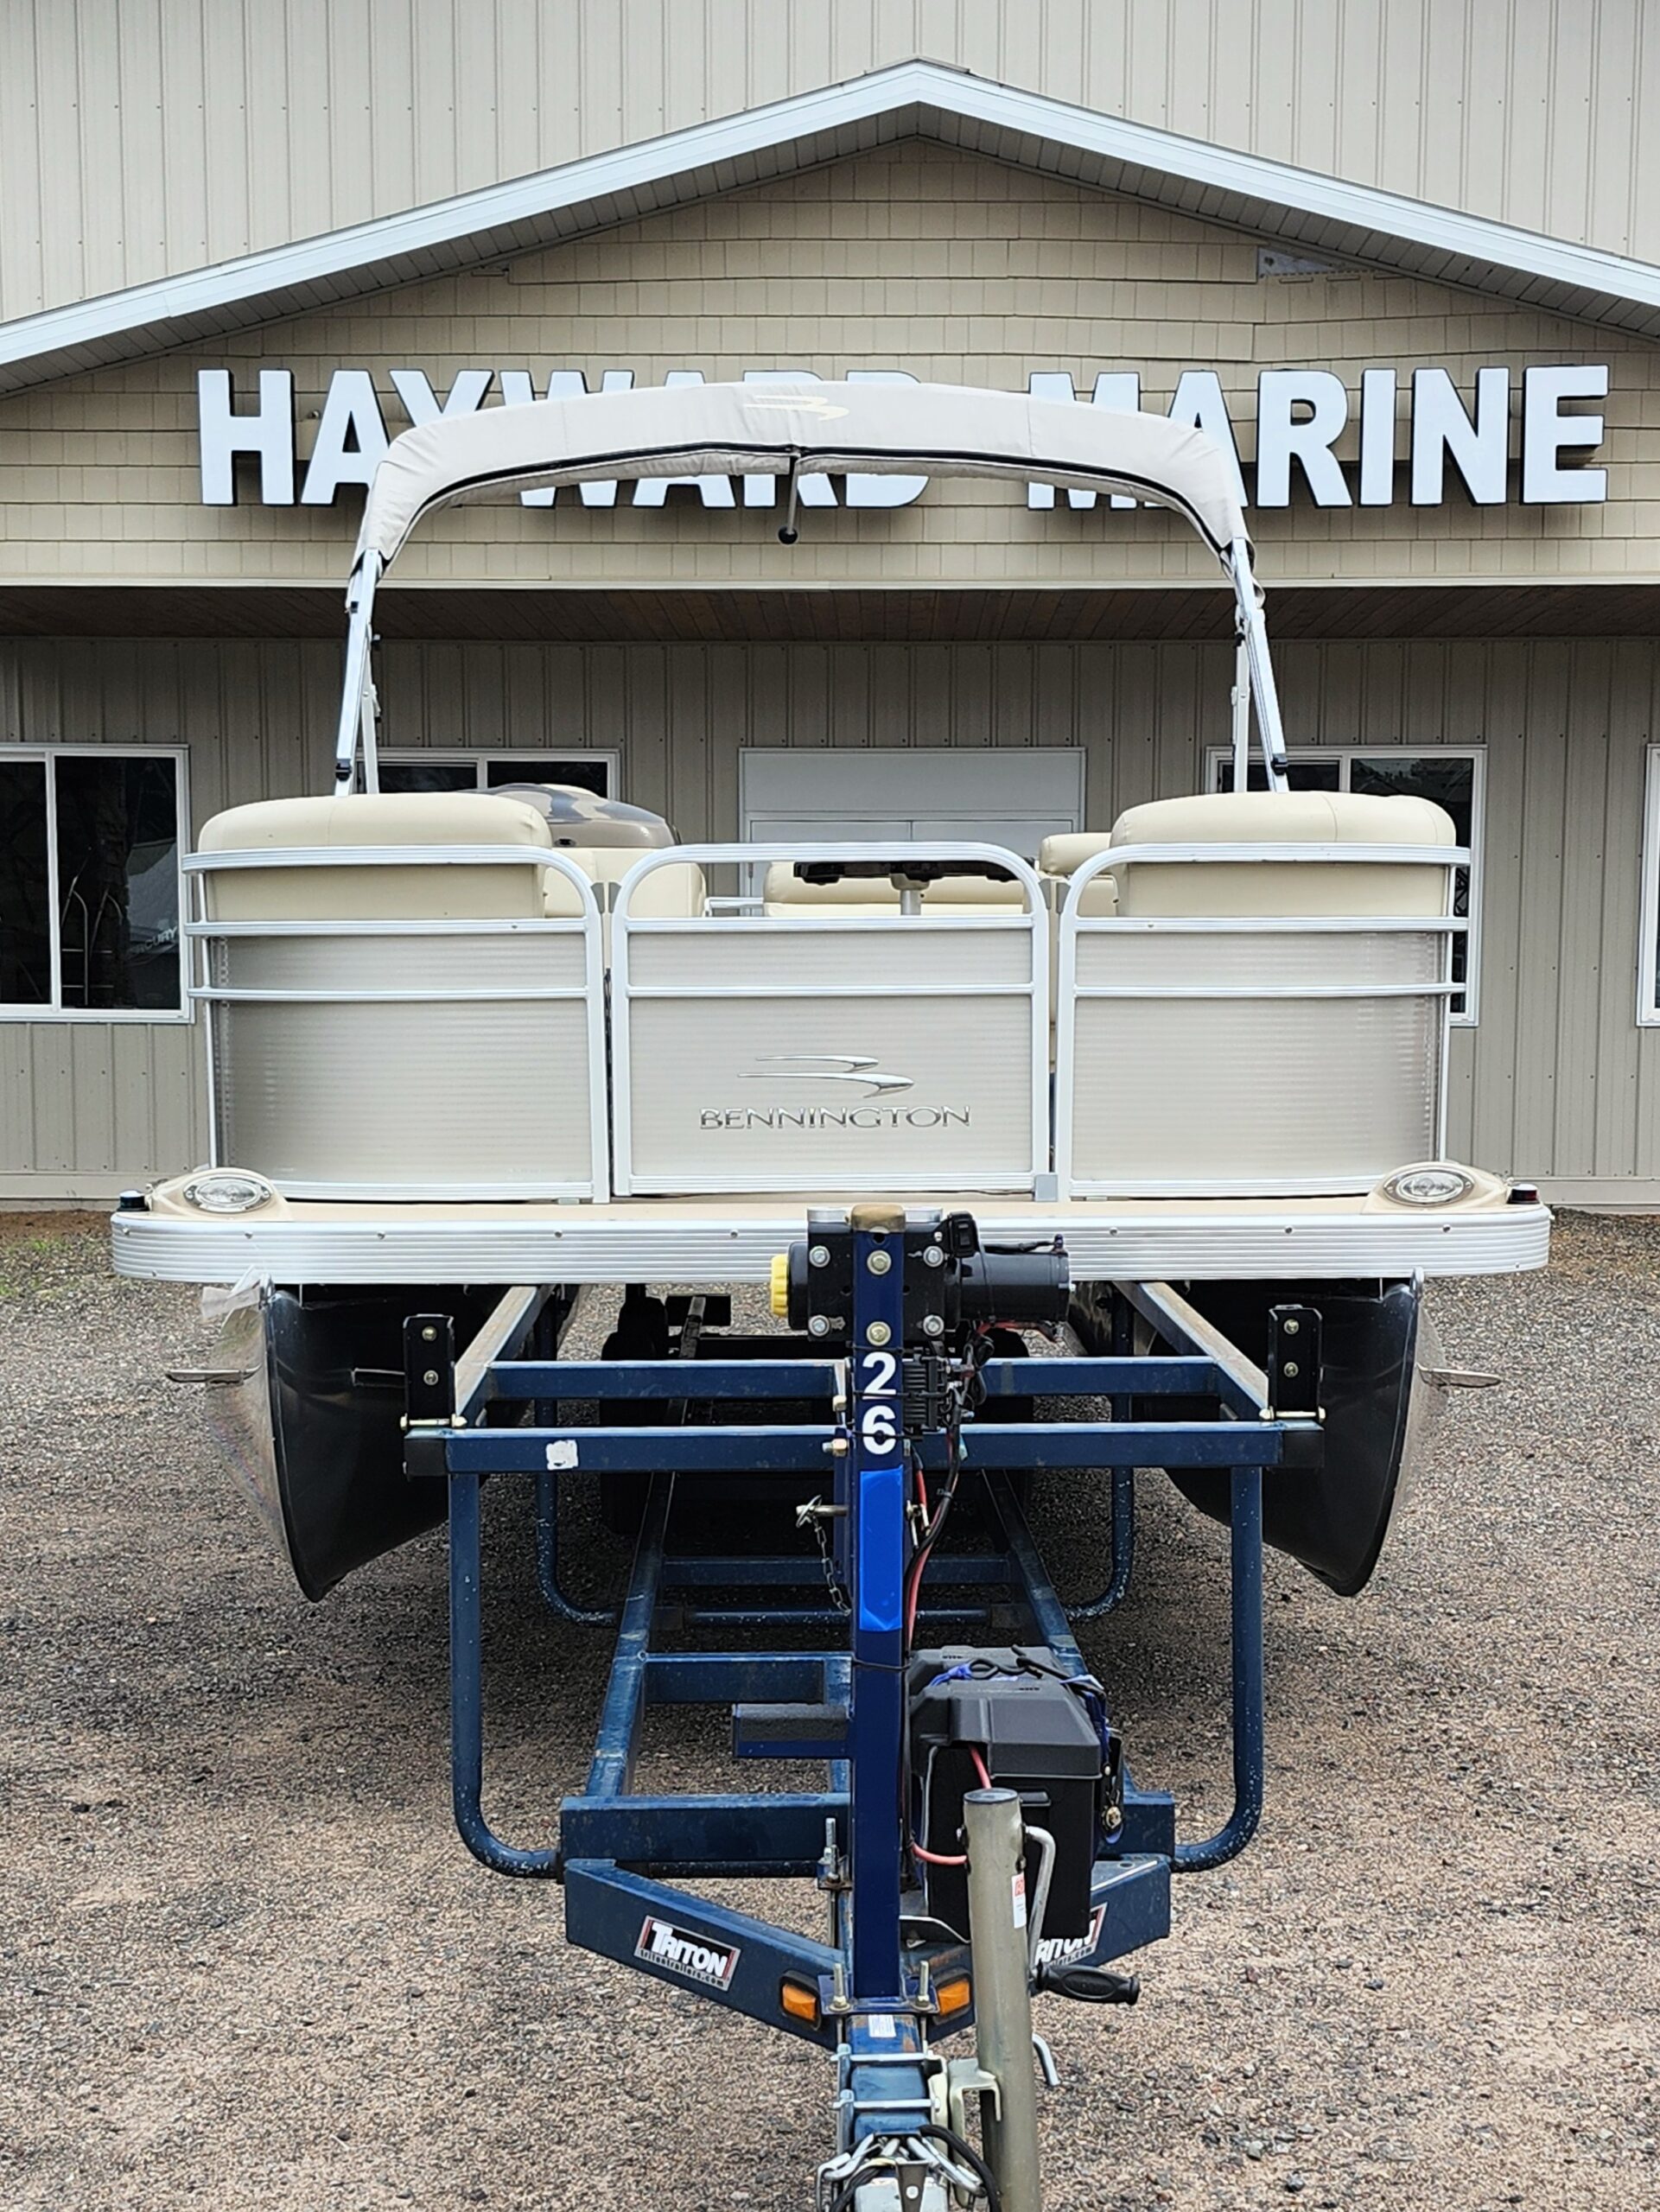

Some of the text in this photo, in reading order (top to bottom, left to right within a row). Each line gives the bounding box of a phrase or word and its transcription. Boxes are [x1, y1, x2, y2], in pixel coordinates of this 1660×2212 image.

[699, 1105, 972, 1130] BENNINGTON
[651, 1921, 728, 1978] TRITON
[1035, 1919, 1097, 1967] RITON
